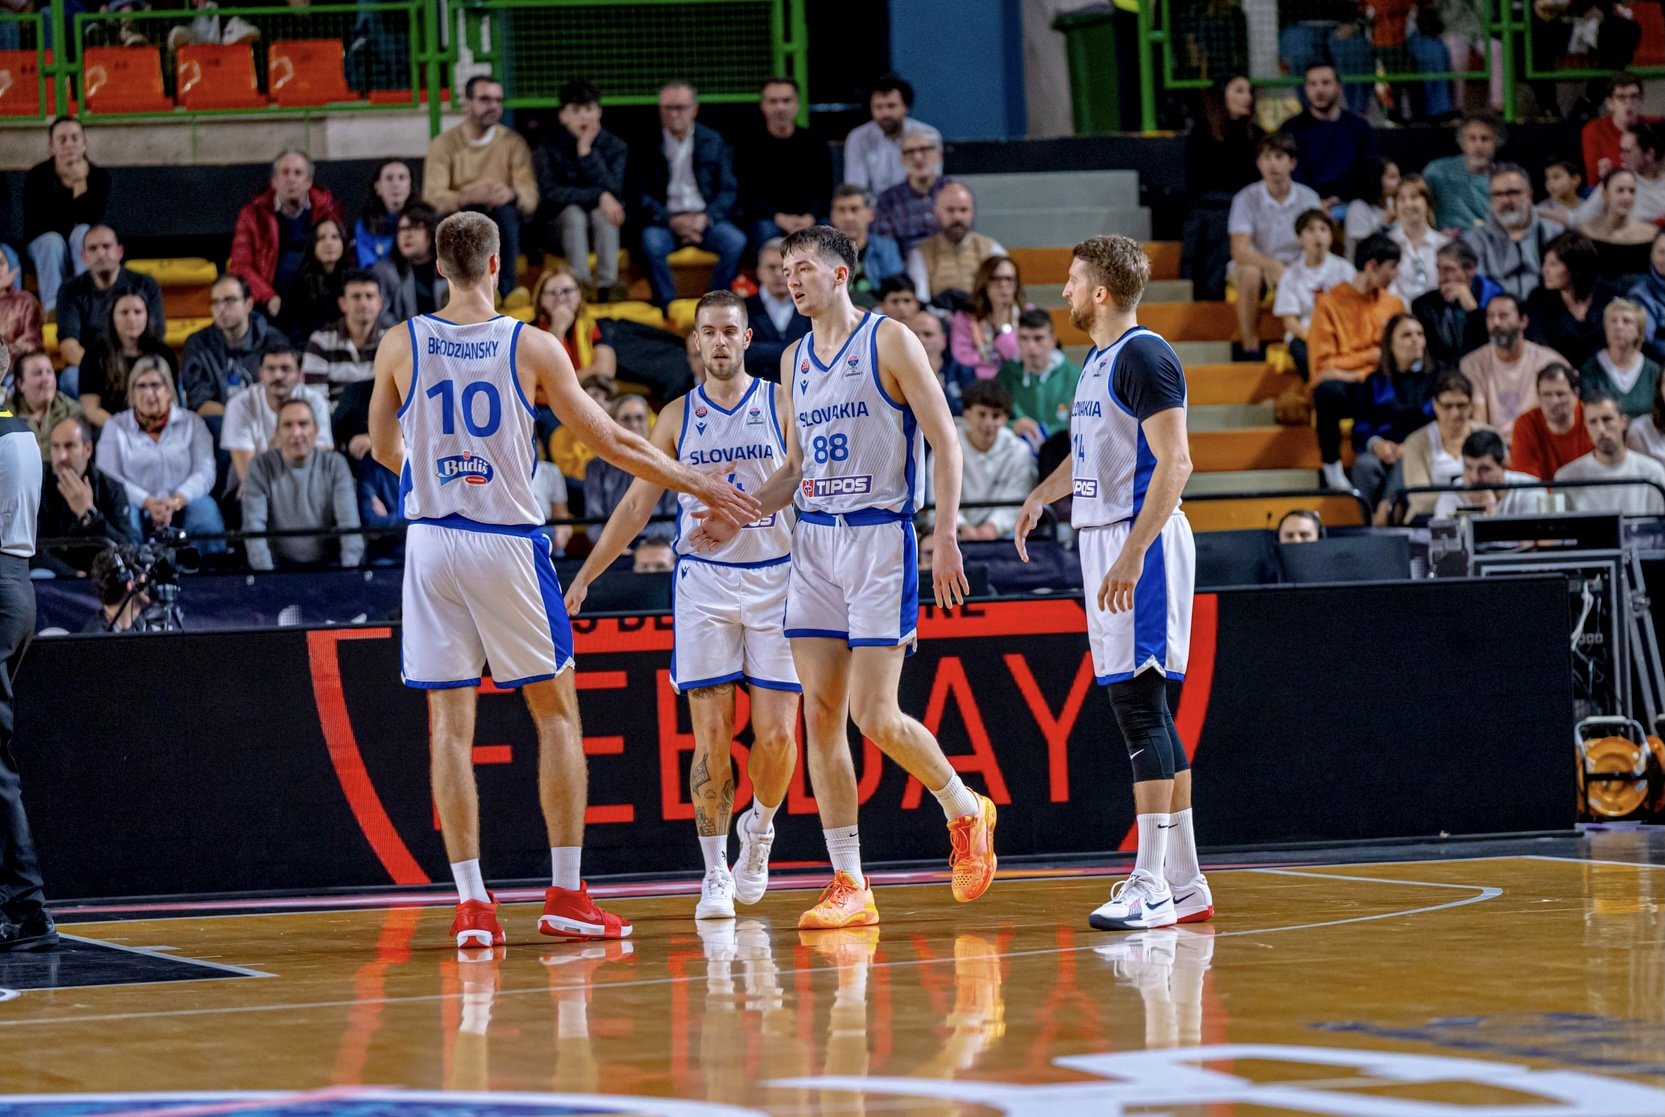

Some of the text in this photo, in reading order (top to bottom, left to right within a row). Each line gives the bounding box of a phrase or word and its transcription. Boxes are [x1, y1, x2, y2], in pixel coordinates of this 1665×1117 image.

[428, 336, 499, 360] BRODZIANSKY
[426, 379, 502, 437] 10
[799, 401, 870, 428] SLOVAKIA
[690, 444, 774, 465] SLOVAKIA
[812, 432, 849, 464] 88
[1073, 433, 1085, 463] 14
[443, 458, 489, 478] Budiš
[816, 477, 868, 495] TIPOS
